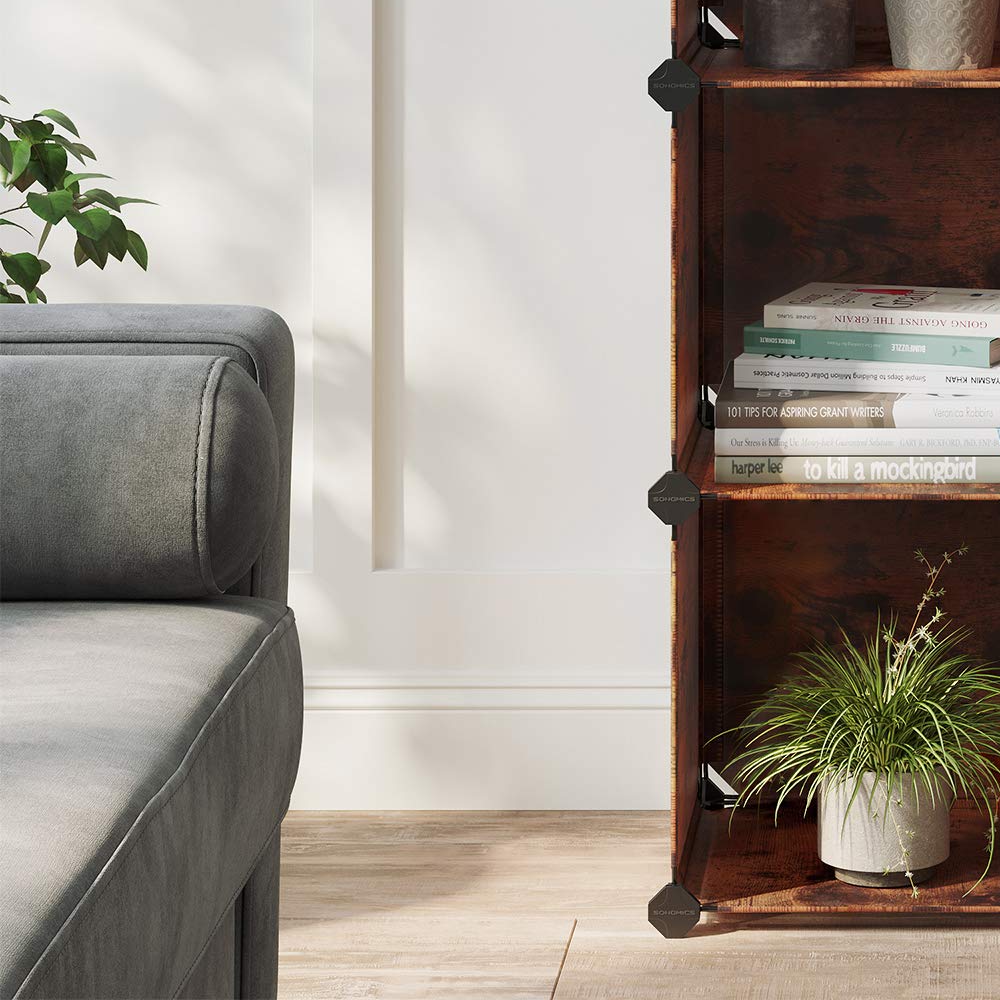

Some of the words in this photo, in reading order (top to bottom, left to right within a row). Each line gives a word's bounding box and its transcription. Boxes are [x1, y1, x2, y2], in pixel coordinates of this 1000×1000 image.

[834, 315, 869, 324] GRAIN
[873, 316, 893, 325] THE
[900, 317, 945, 327] AGAINST
[951, 320, 988, 329] GOING
[753, 370, 780, 378] Practices
[781, 371, 810, 379] Cosmetic
[830, 372, 852, 380] Million
[852, 372, 878, 380] Building
[887, 374, 904, 382] Steps
[905, 375, 926, 383] Simple
[945, 376, 968, 384] KHAN
[970, 377, 1000, 385] YASMIN
[727, 406, 742, 418] 101
[744, 406, 760, 418] TIPS
[762, 406, 779, 418] FOR
[780, 406, 818, 418] ASPIRING
[819, 406, 849, 418] GRANT
[850, 406, 885, 418] WRITERS
[730, 438, 743, 447] Our
[744, 438, 761, 447] Stress
[761, 438, 767, 447] is
[768, 438, 788, 449] Killing
[731, 459, 766, 478] harper
[767, 458, 784, 474] lee
[803, 458, 822, 480] to
[826, 456, 849, 480] kill
[853, 460, 866, 480] a
[870, 456, 977, 484] mockingbird
